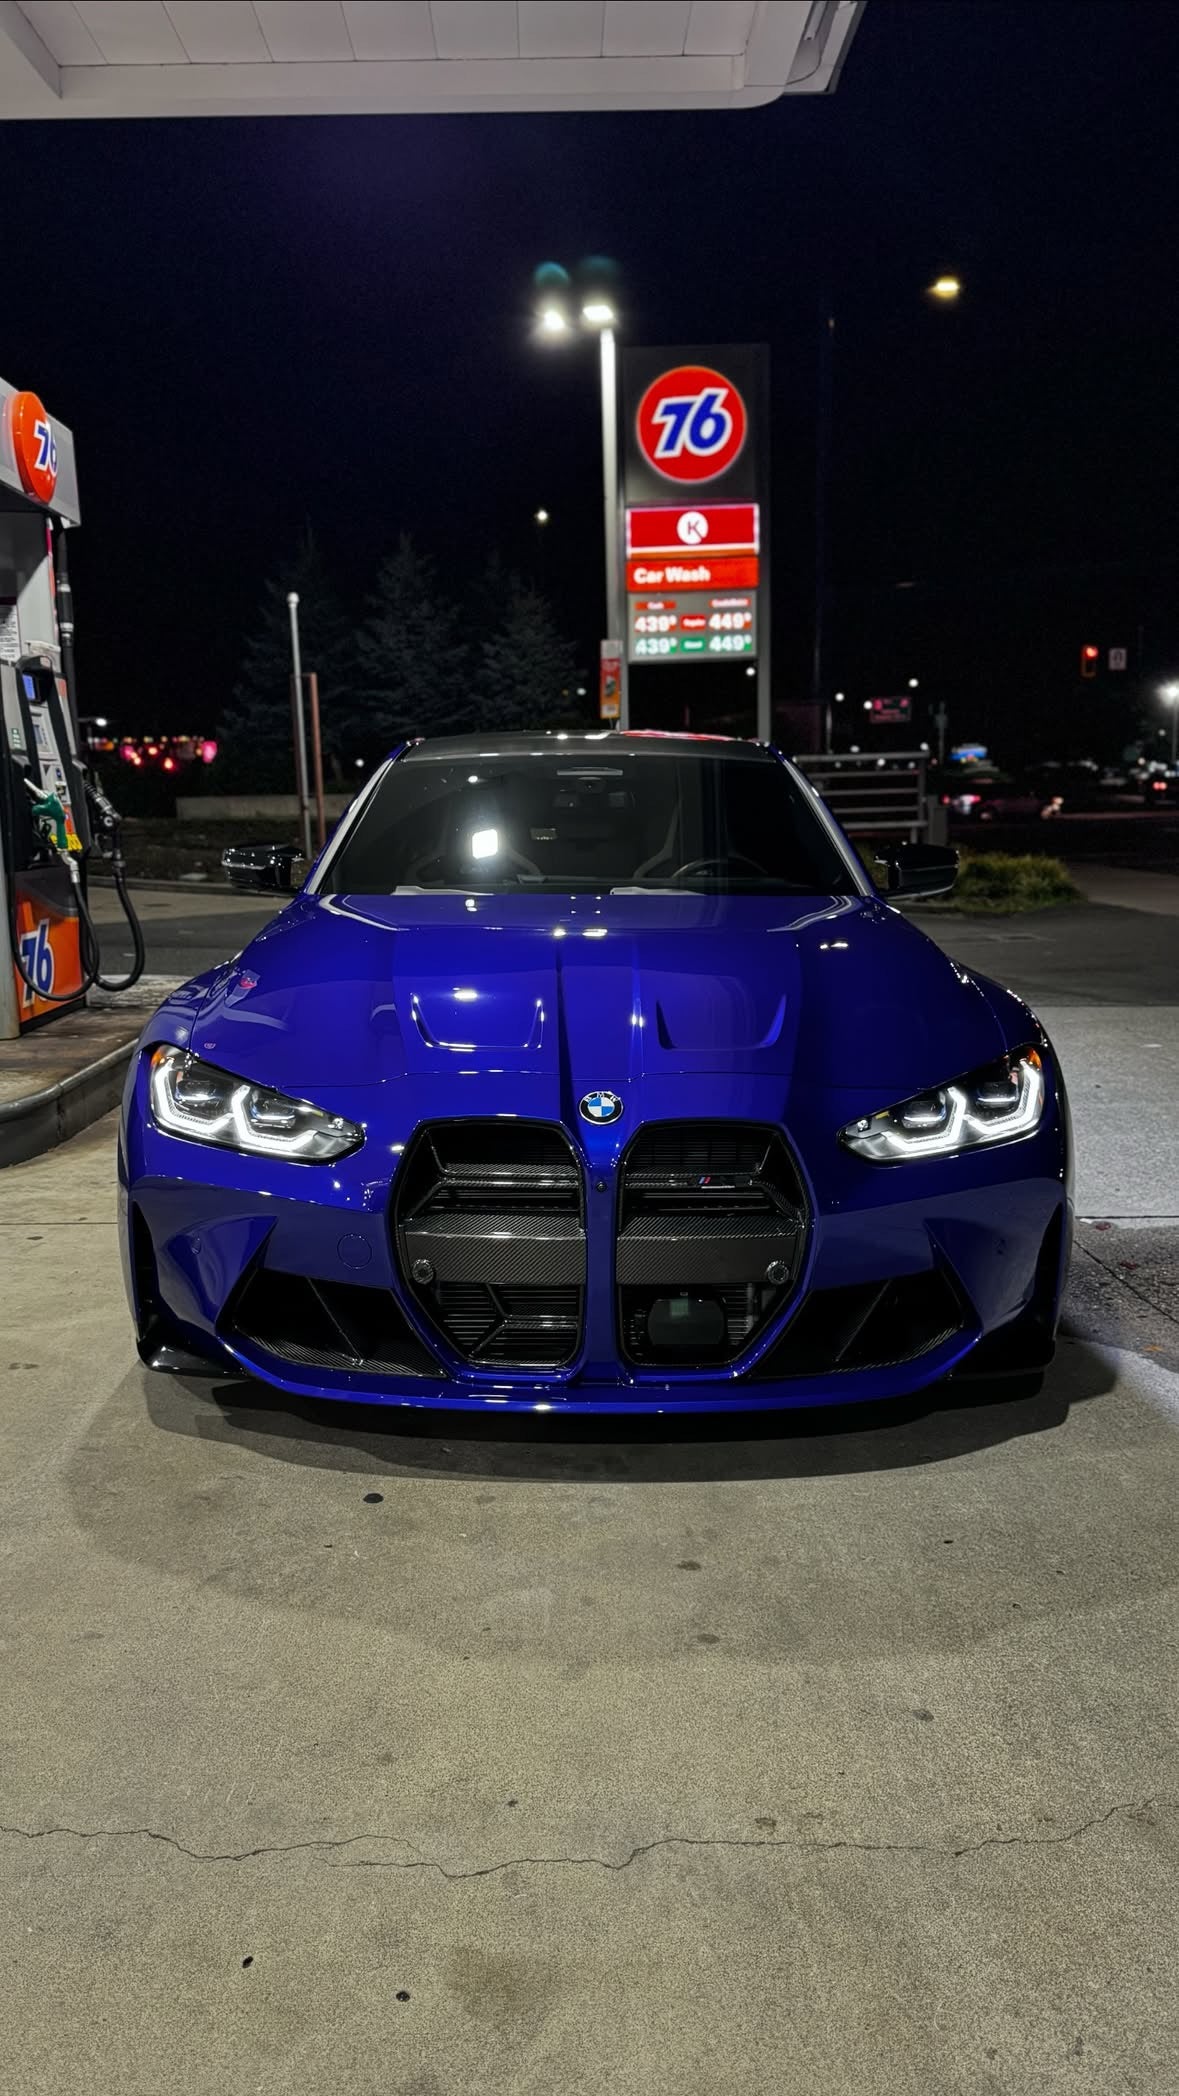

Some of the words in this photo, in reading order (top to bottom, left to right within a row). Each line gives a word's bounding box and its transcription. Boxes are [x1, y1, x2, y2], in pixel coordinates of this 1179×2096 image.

[651, 387, 733, 459] 76
[687, 520, 703, 539] K
[633, 567, 664, 584] Car
[665, 565, 711, 583] Wash
[20, 918, 54, 1009] 76
